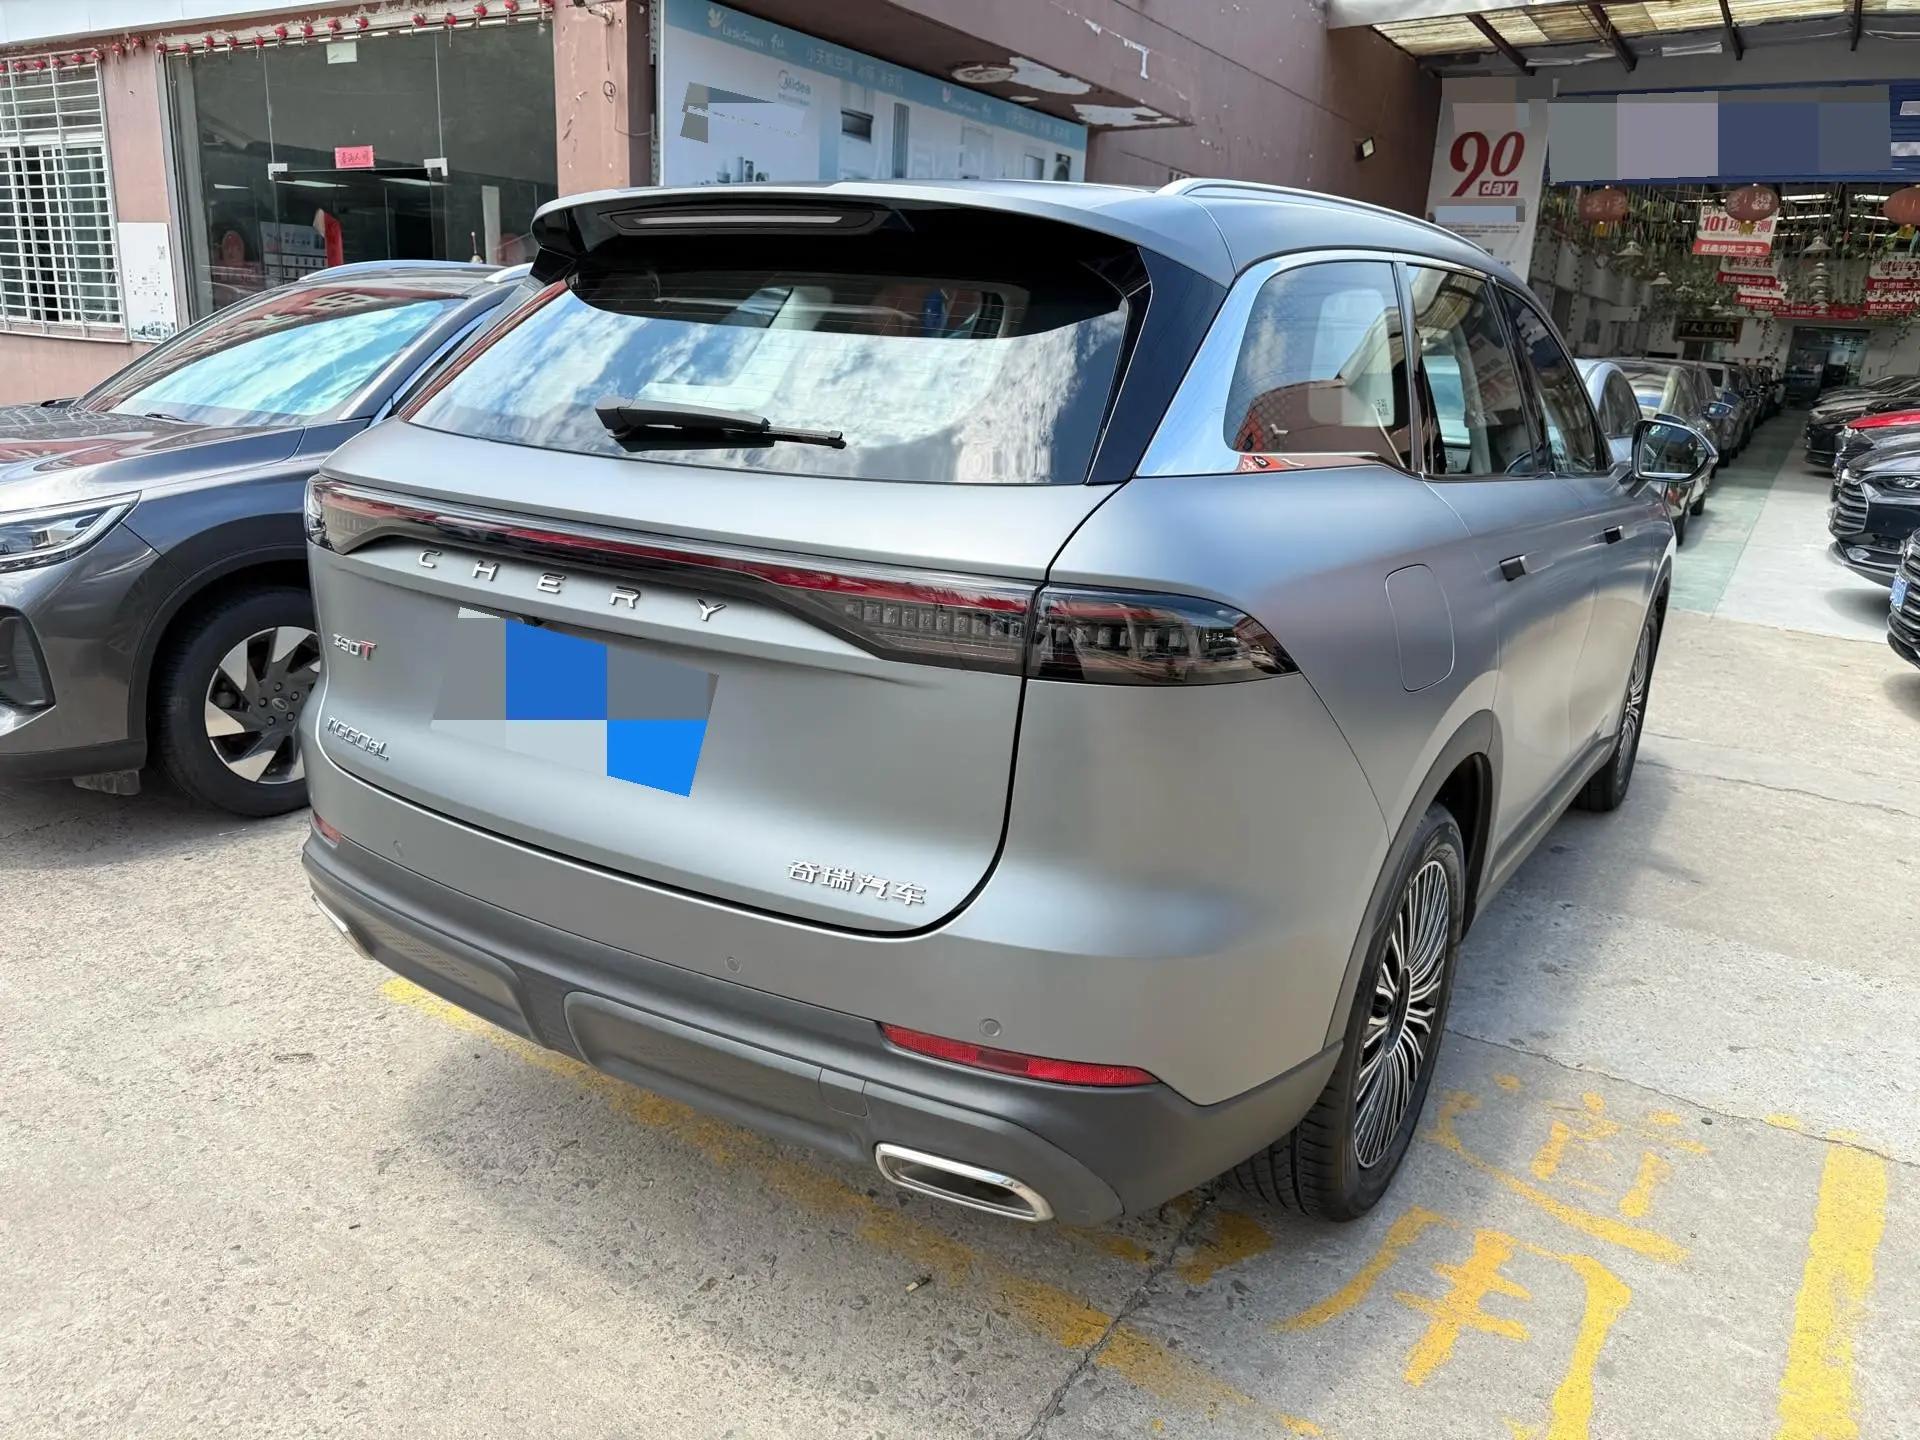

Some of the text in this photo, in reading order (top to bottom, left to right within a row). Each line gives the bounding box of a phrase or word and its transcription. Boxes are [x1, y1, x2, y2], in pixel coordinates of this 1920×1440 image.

[778, 72, 811, 95] Midea
[1449, 130, 1525, 198] 90
[1481, 181, 1515, 196] day
[1703, 215, 1773, 233] 101项测
[416, 548, 728, 623] CHERY
[787, 858, 929, 908] 奇瑞汽车
